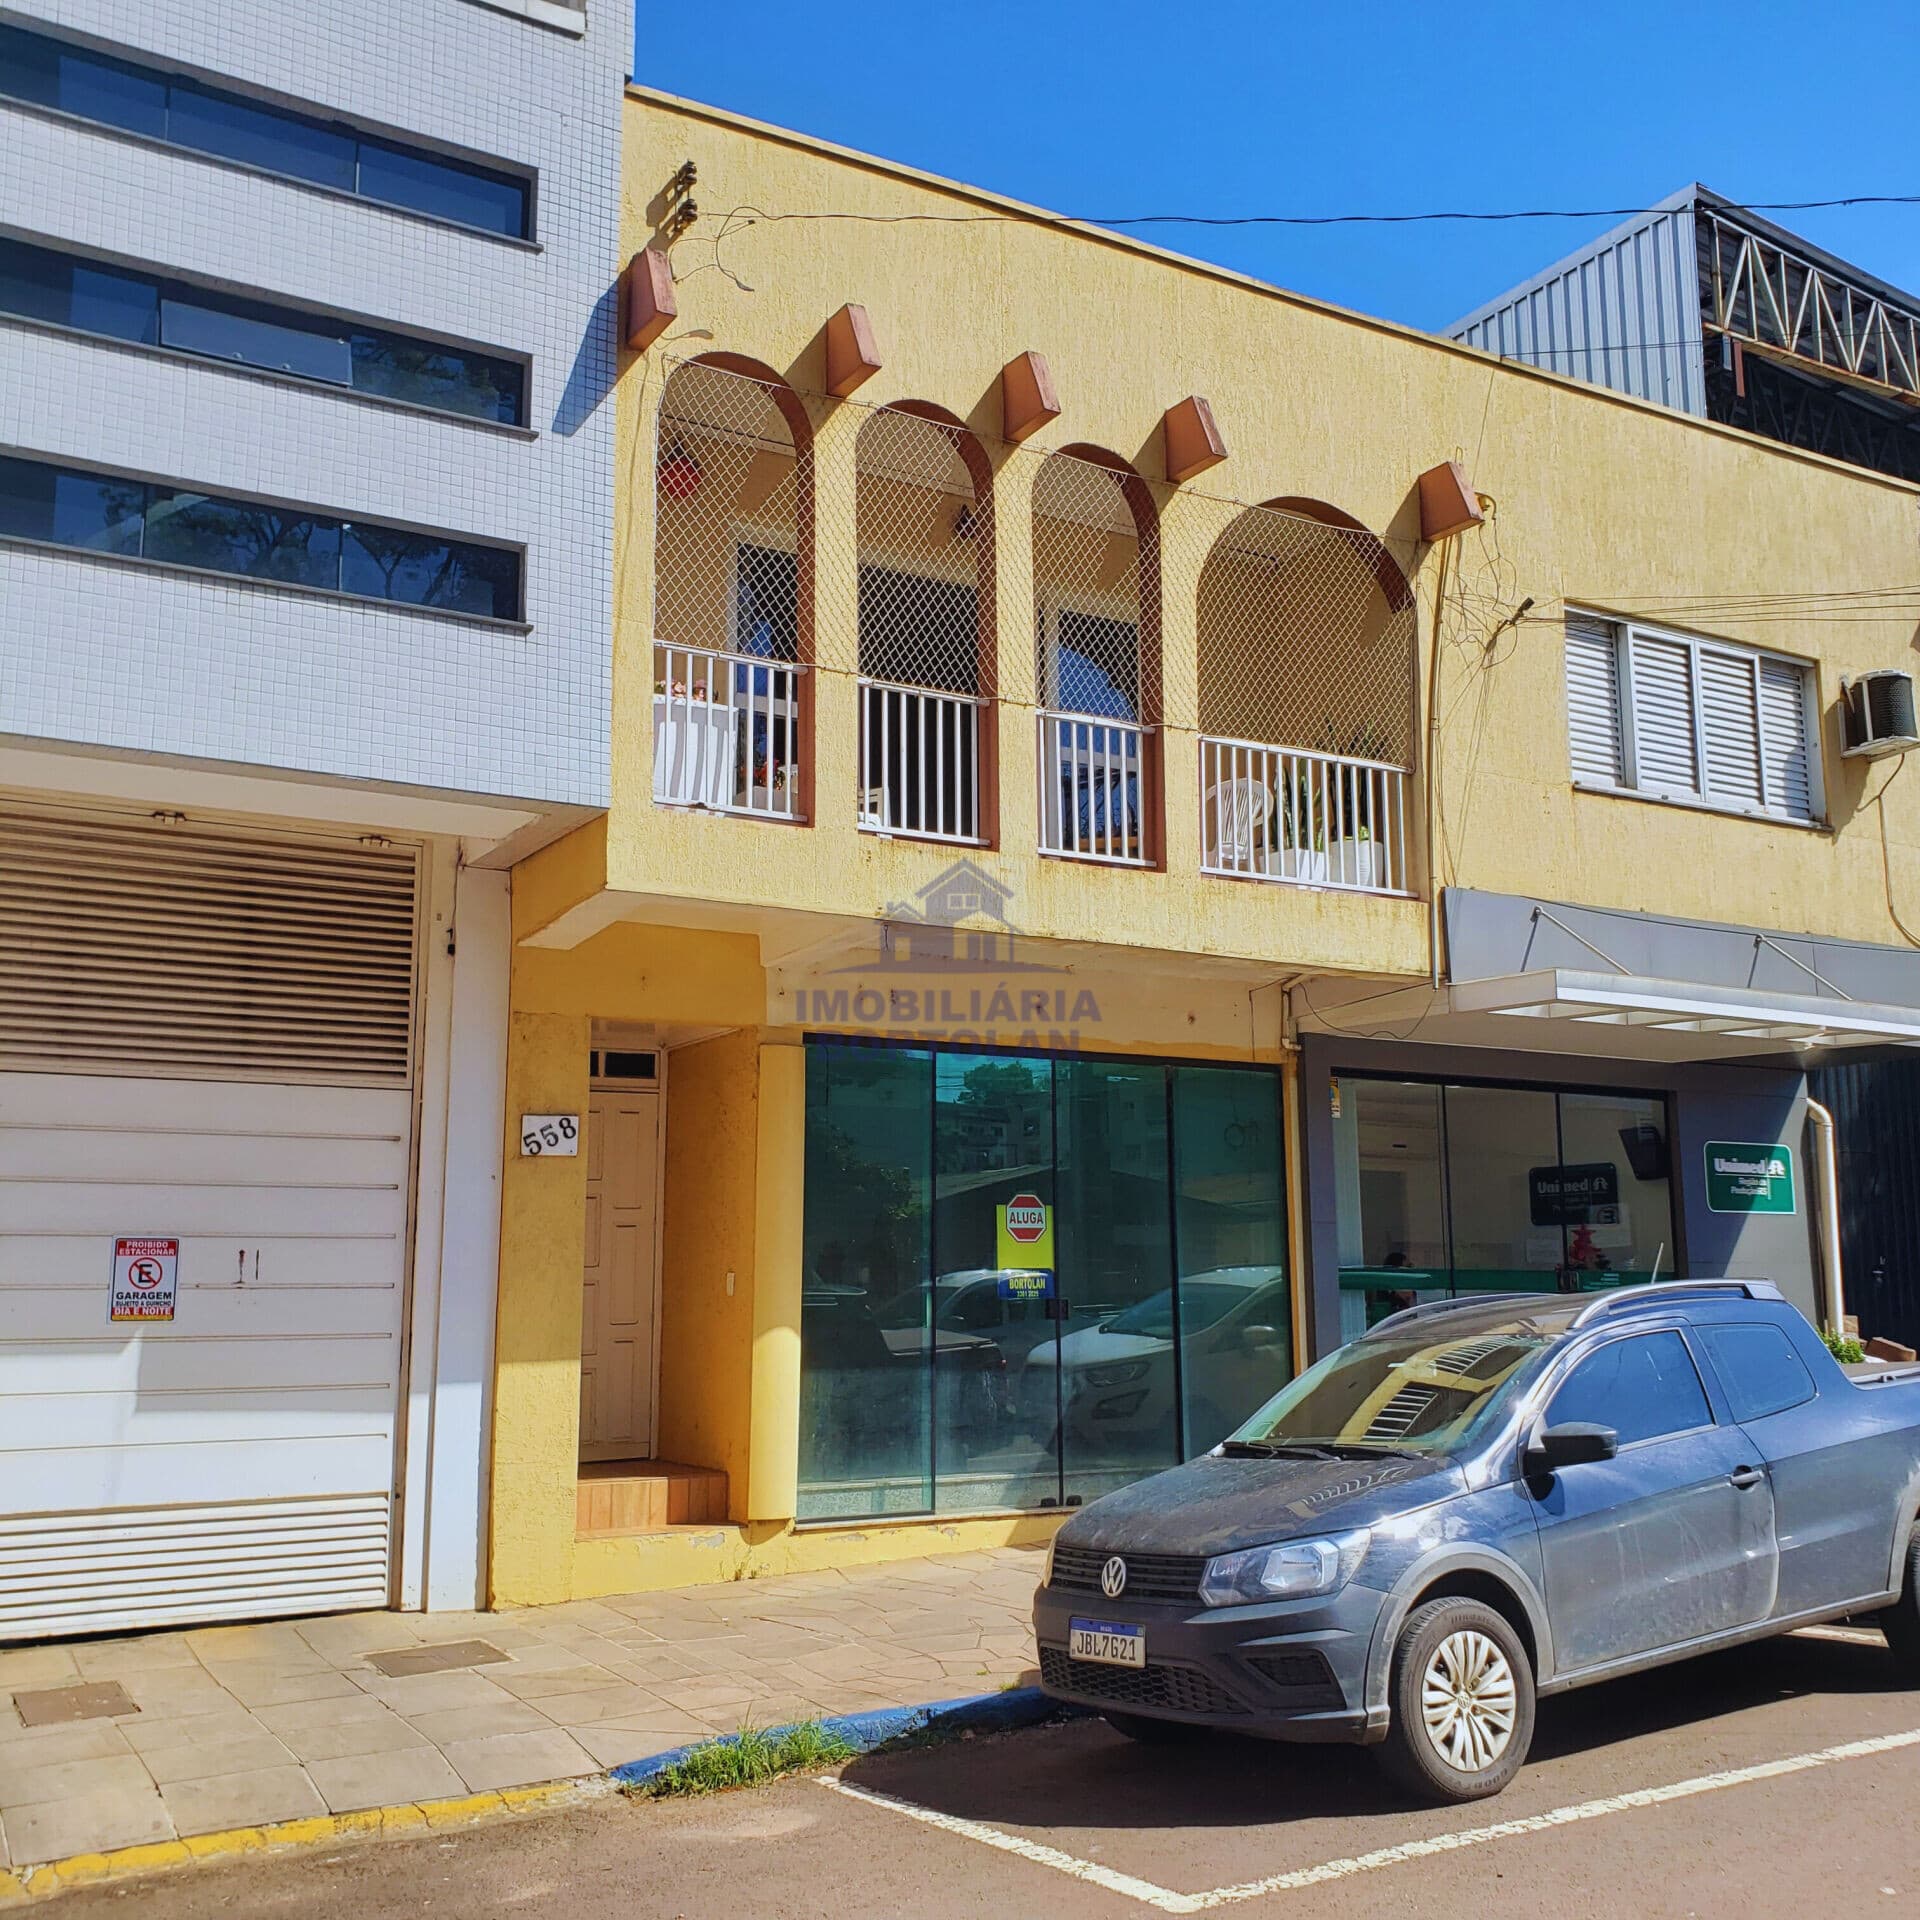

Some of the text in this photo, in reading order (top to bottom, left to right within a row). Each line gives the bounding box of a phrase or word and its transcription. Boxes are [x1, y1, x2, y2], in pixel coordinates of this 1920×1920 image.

[523, 1117, 577, 1155] 558
[1009, 1212, 1044, 1224] ALUGA
[126, 1241, 168, 1249] PROIBIDO
[119, 1248, 175, 1256] ESTACIONAR
[116, 1292, 172, 1300] GARAGEM
[114, 1307, 131, 1315] DIA
[142, 1307, 171, 1315] NOITE
[1077, 1632, 1136, 1661] JBL7G21
